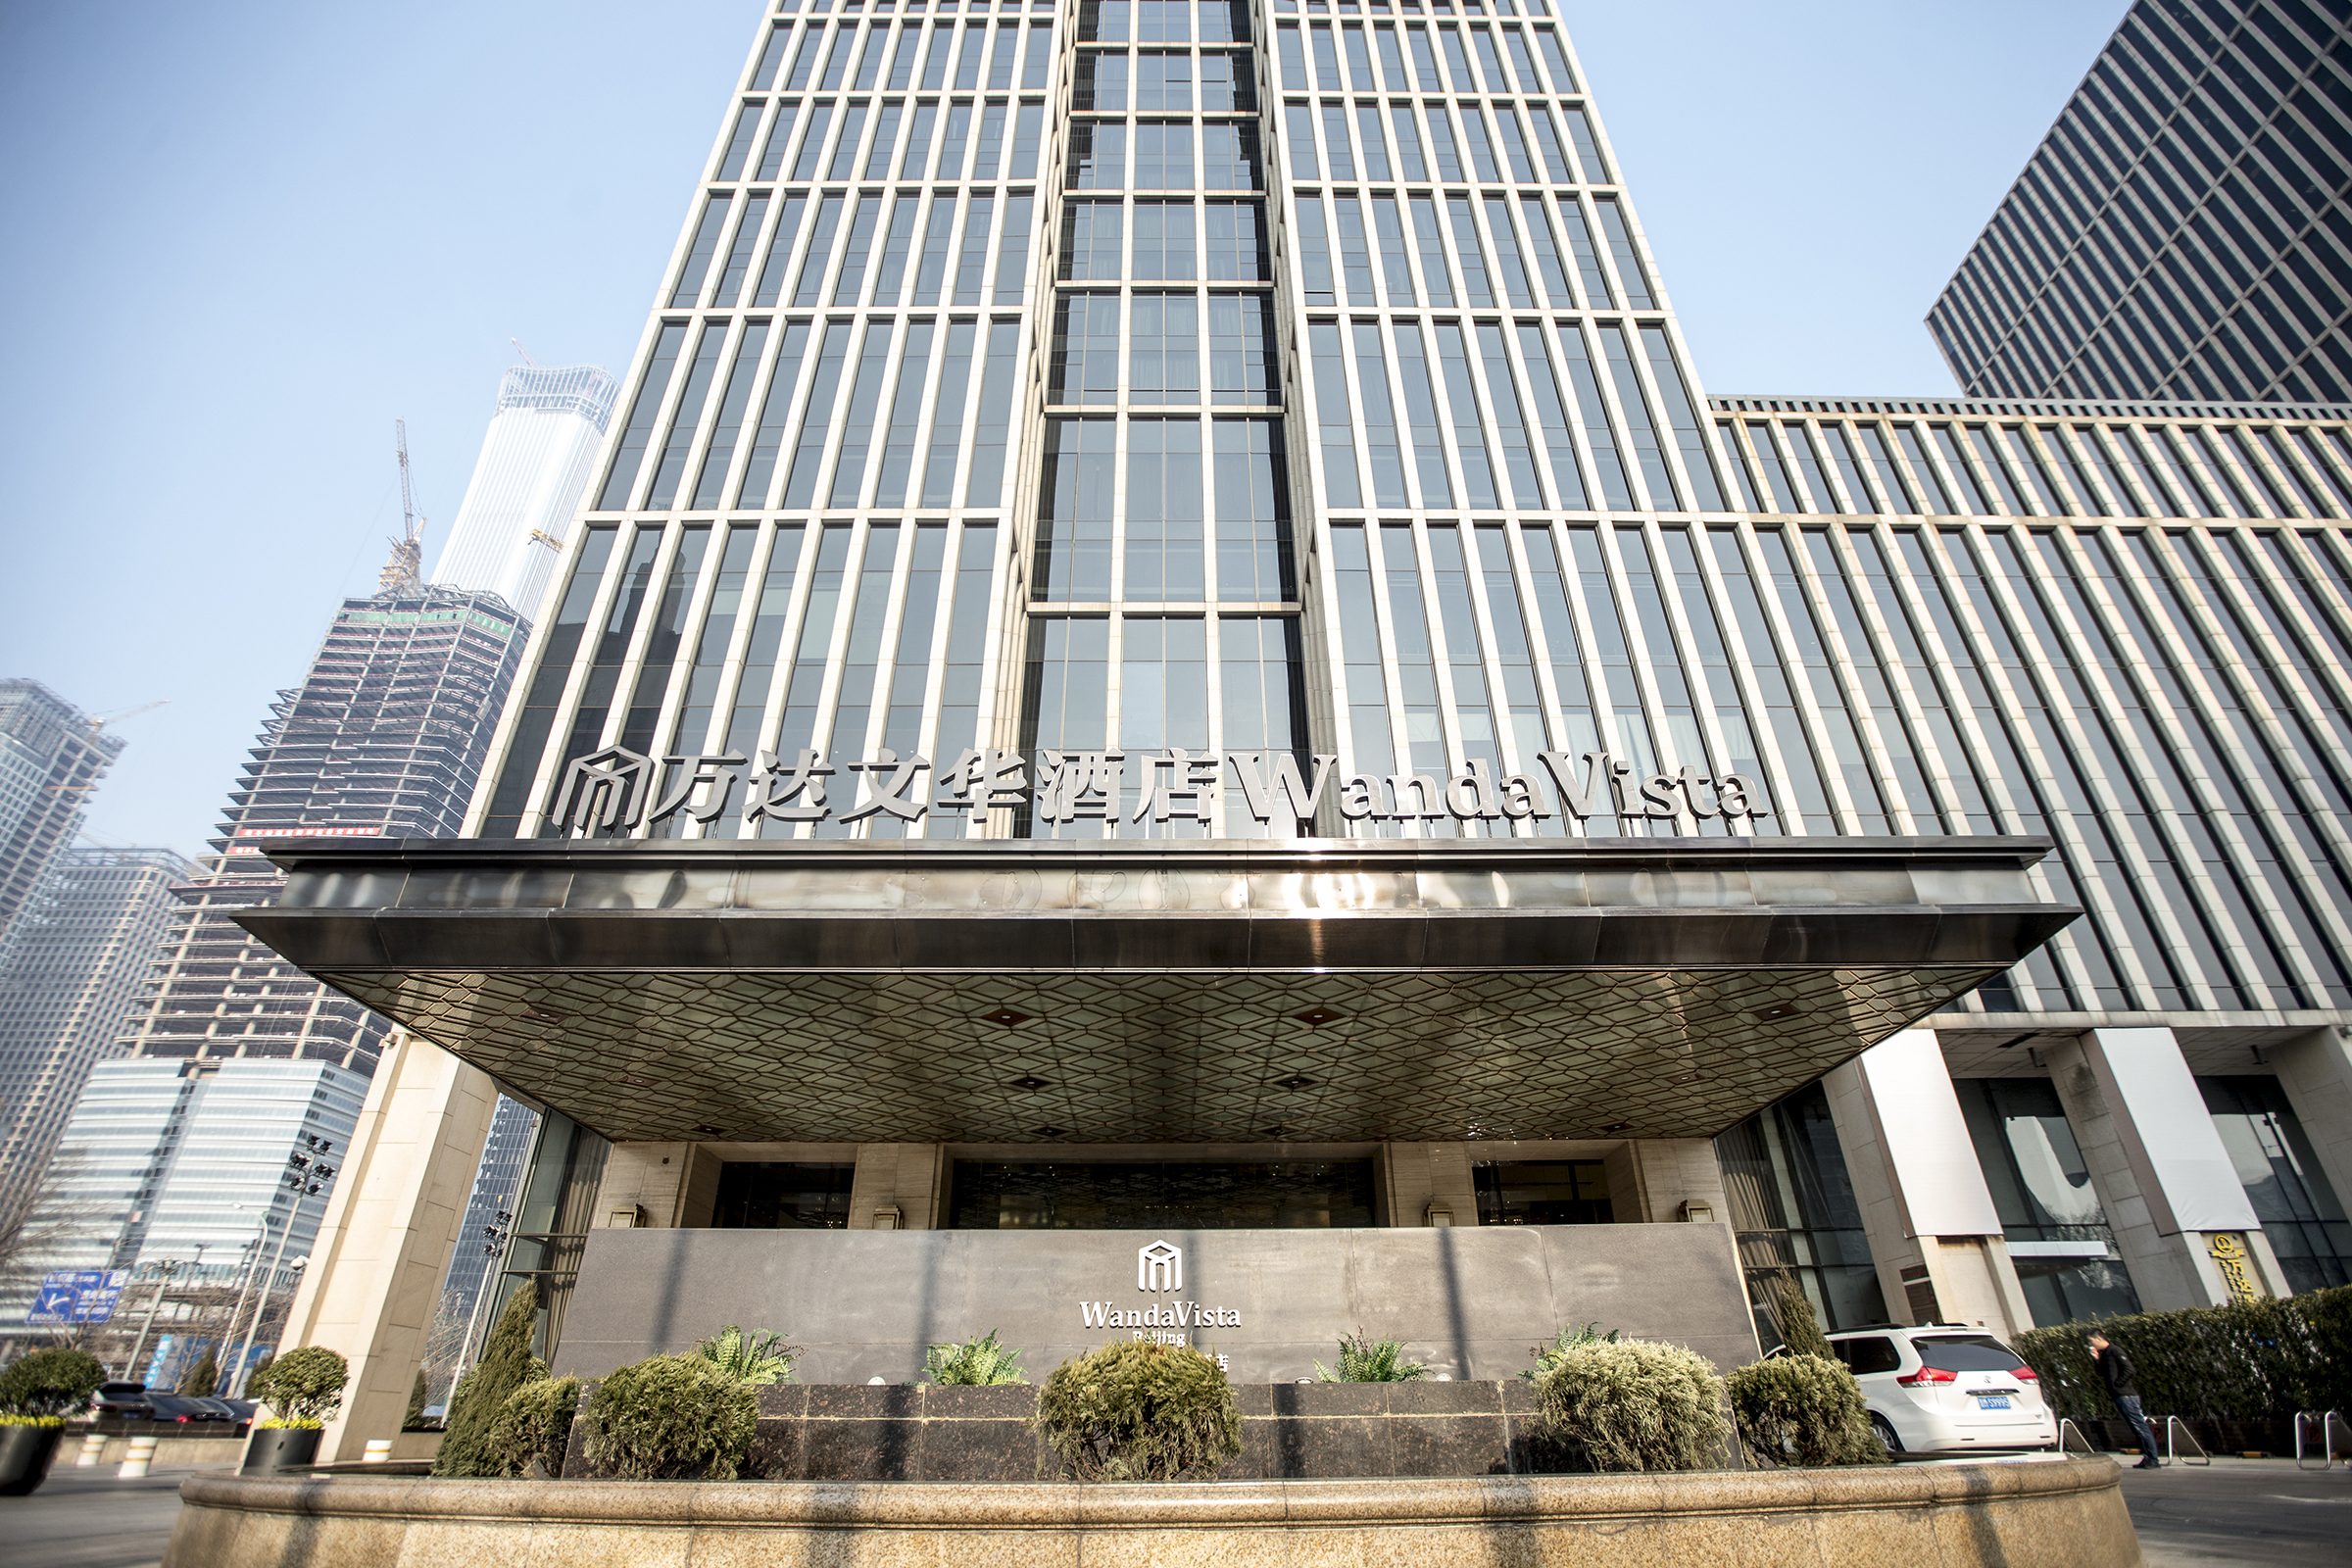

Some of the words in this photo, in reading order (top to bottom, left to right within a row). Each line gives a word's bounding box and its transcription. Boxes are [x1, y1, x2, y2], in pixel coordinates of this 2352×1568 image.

[648, 748, 1218, 824] 万达文华酒店
[1228, 751, 1768, 821] WandaVista
[1079, 1300, 1242, 1328] WandaVista
[1132, 1331, 1186, 1348] Beijing
